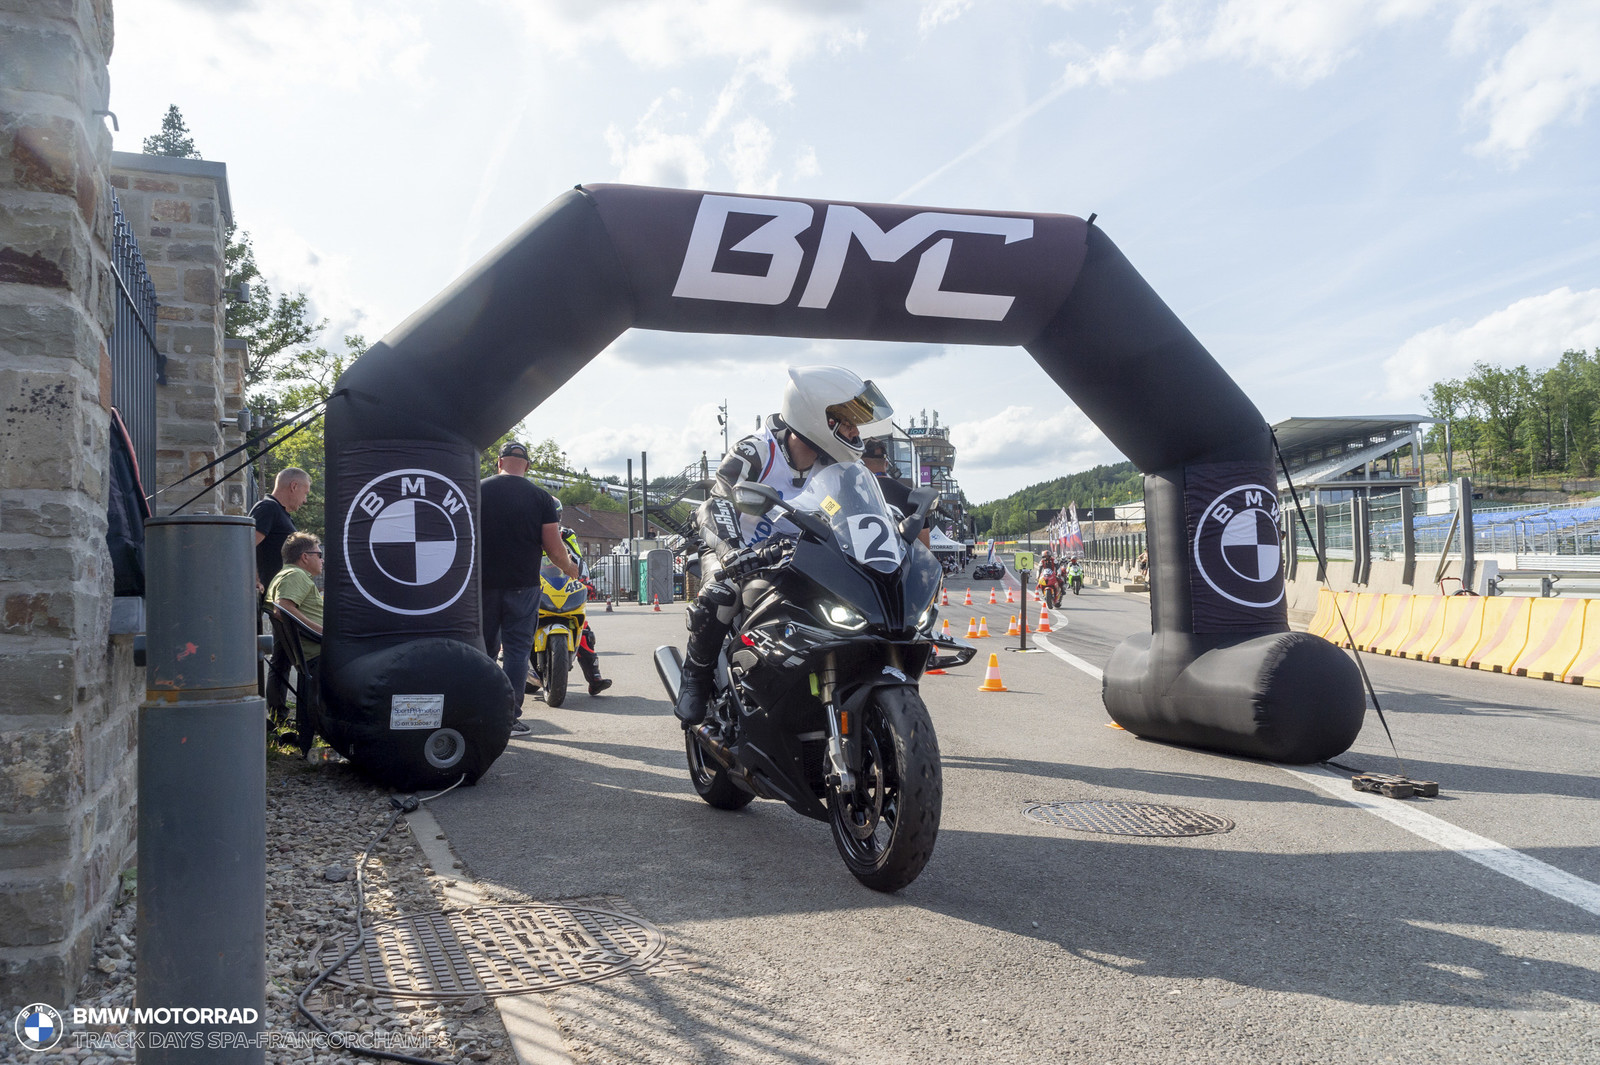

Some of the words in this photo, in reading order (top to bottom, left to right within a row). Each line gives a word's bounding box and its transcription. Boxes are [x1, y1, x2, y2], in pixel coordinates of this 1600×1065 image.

[672, 194, 1034, 321] BMC
[360, 477, 463, 517] BMW
[1211, 491, 1280, 524] BMW
[858, 516, 896, 560] 2
[1020, 556, 1028, 568] C
[564, 580, 583, 593] 46
